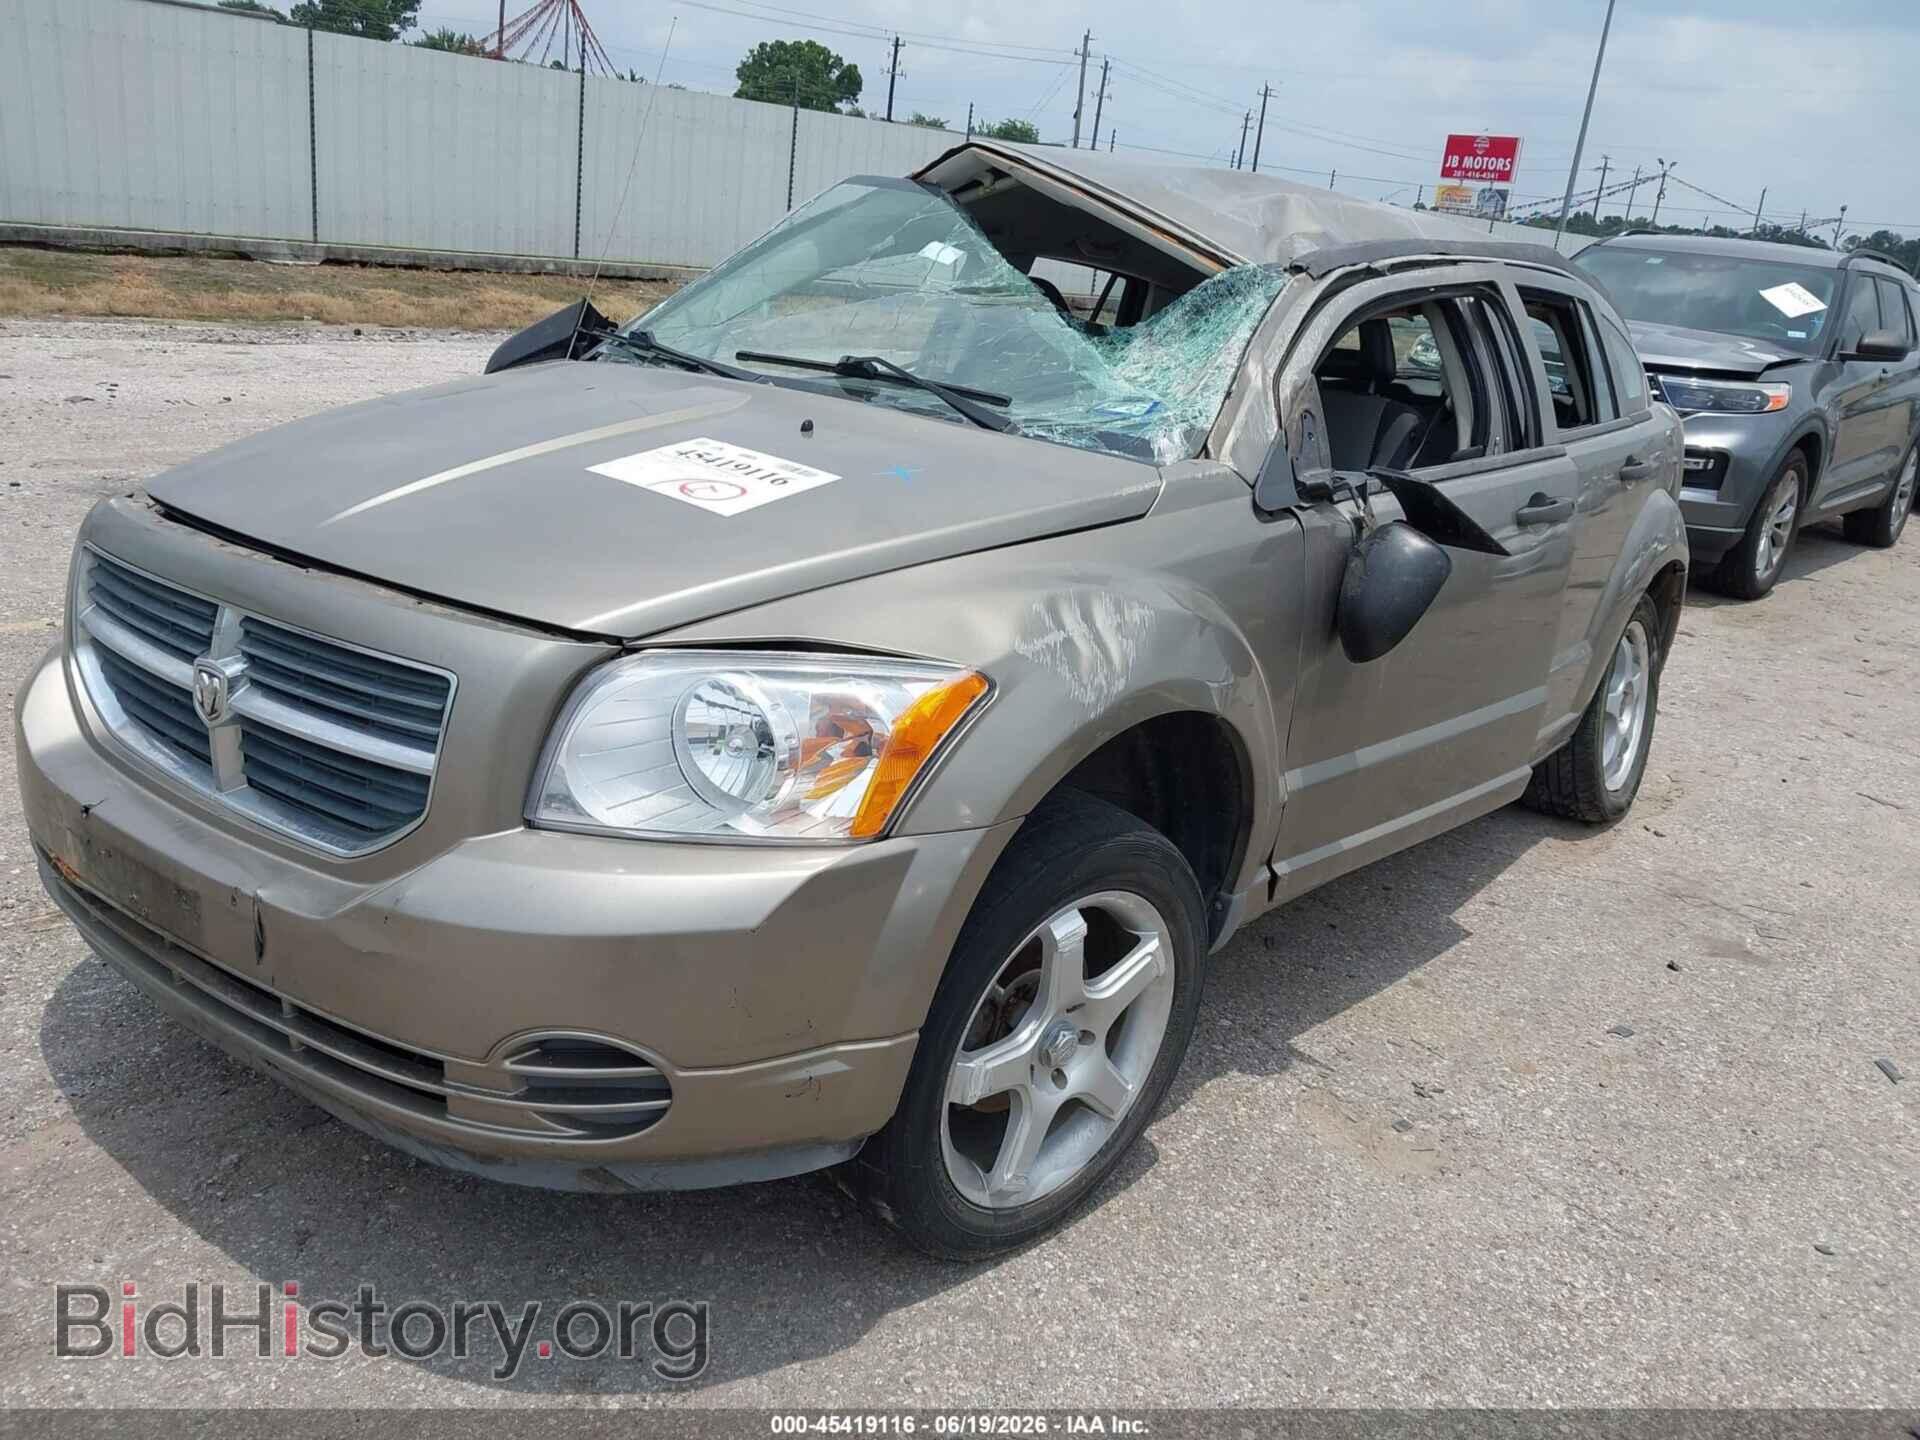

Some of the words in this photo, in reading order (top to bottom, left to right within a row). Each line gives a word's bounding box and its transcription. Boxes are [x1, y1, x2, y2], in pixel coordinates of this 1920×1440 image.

[1445, 155, 1460, 168] JB
[1462, 155, 1512, 171] MOTORS
[676, 449, 790, 486] 45419116
